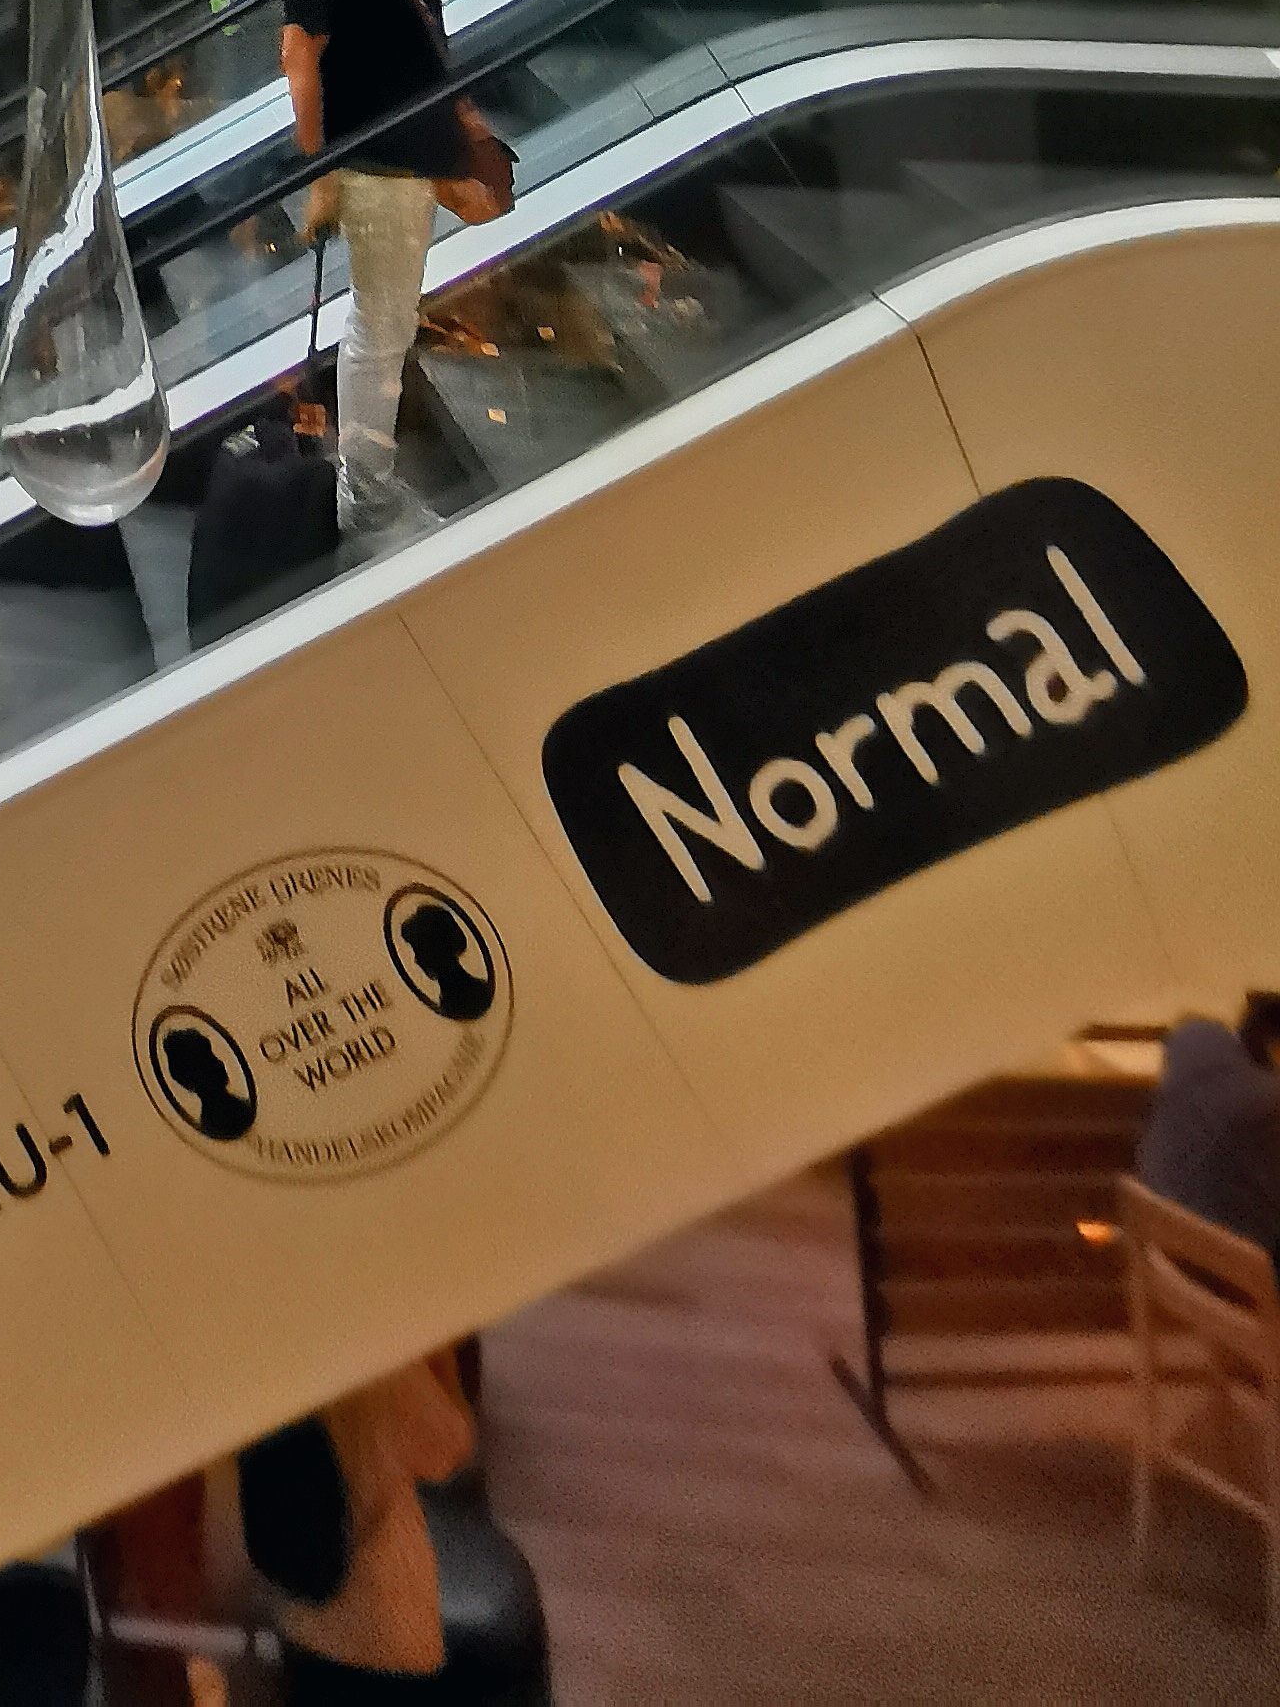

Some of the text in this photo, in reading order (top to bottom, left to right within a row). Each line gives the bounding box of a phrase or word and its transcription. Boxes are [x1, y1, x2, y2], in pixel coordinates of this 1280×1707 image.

[618, 544, 1147, 904] Normal
[258, 979, 393, 1065] OVER THE
[284, 967, 328, 1008] ALL
[293, 1024, 397, 1092] WORLD
